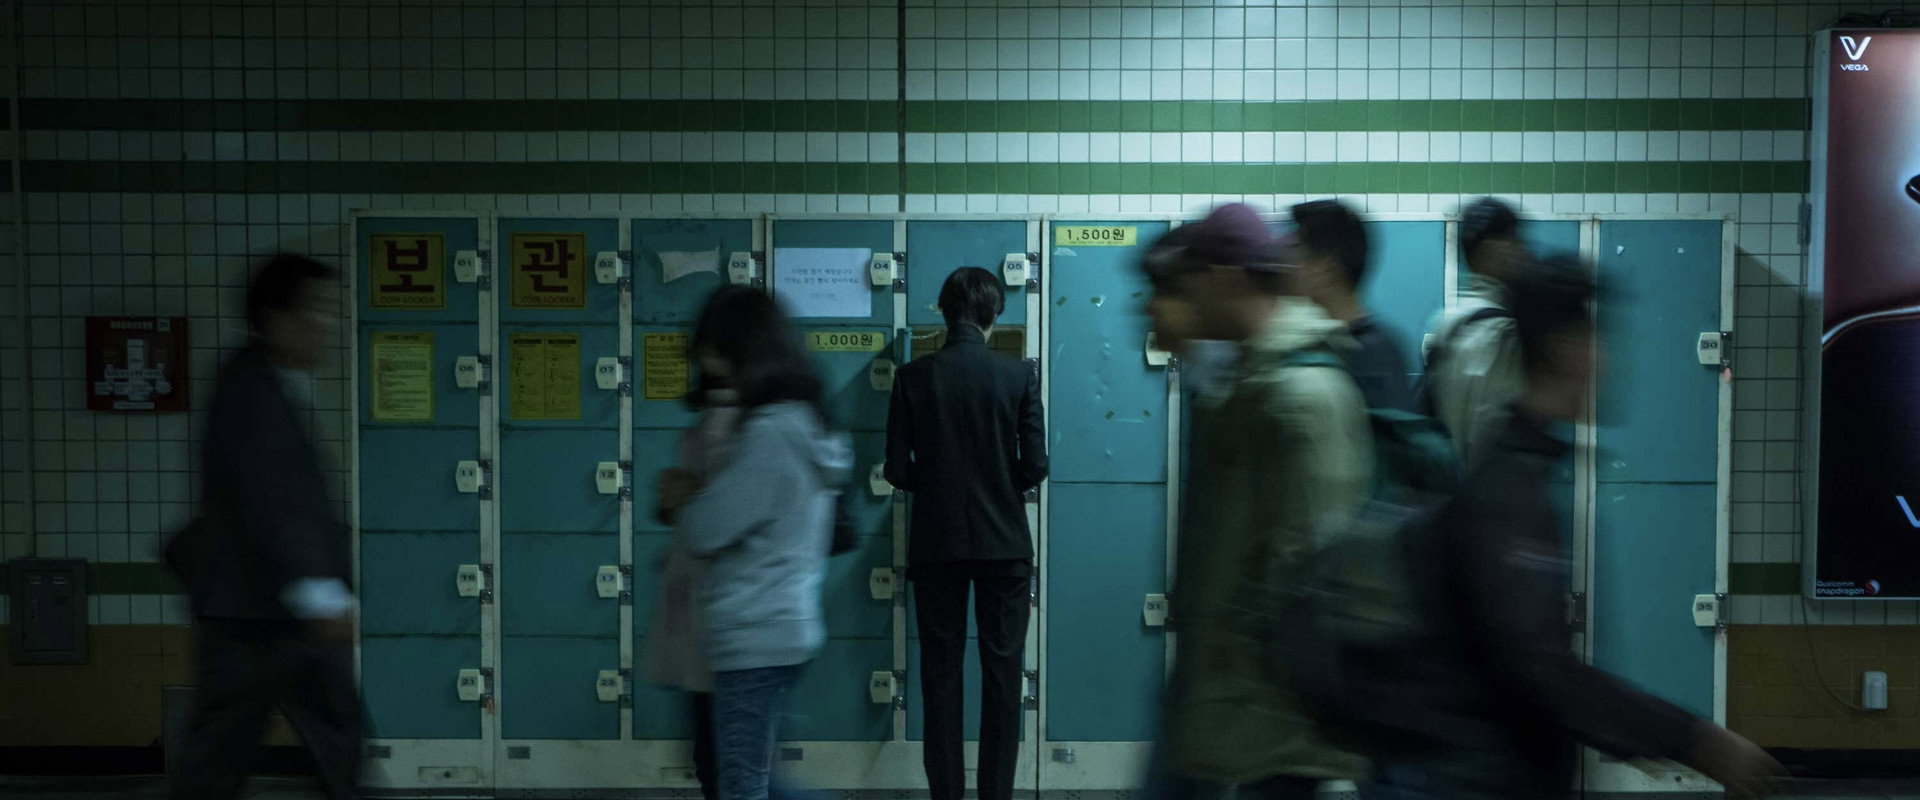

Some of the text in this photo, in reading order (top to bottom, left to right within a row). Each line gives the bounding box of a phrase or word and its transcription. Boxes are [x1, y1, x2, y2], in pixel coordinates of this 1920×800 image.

[1067, 229, 1125, 241] 1,500원
[380, 239, 435, 292] 보
[521, 239, 576, 292] 관
[599, 260, 614, 268] 02
[732, 261, 747, 269] 03
[874, 262, 889, 270] 04
[1007, 262, 1022, 270] 05
[815, 334, 873, 347] 1,000원
[1702, 341, 1718, 349] 30
[599, 366, 615, 374] 07
[601, 471, 615, 479] 12
[601, 574, 615, 582] 17
[1816, 580, 1855, 588] Qualcomm
[1816, 588, 1865, 596] snapdragon
[1697, 603, 1713, 611] 35
[600, 678, 616, 686] 22
